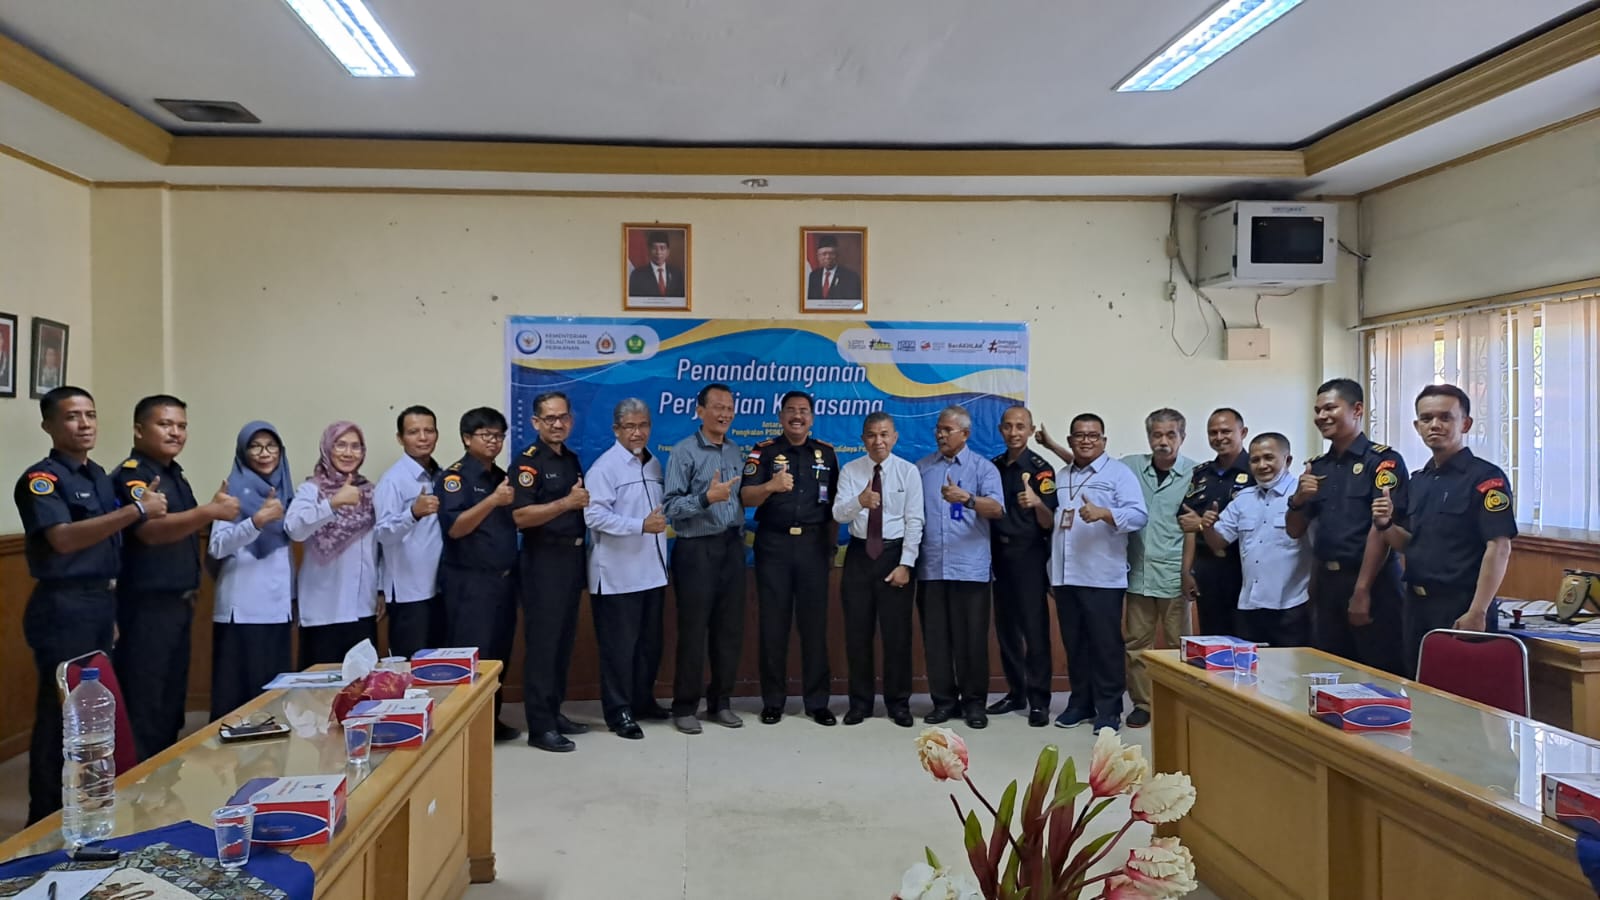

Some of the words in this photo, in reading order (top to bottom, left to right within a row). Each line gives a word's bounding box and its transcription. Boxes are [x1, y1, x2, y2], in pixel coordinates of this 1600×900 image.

[677, 358, 866, 388] Penandatanganan
[659, 391, 765, 420] Perjian
[772, 392, 883, 416] Kasama
